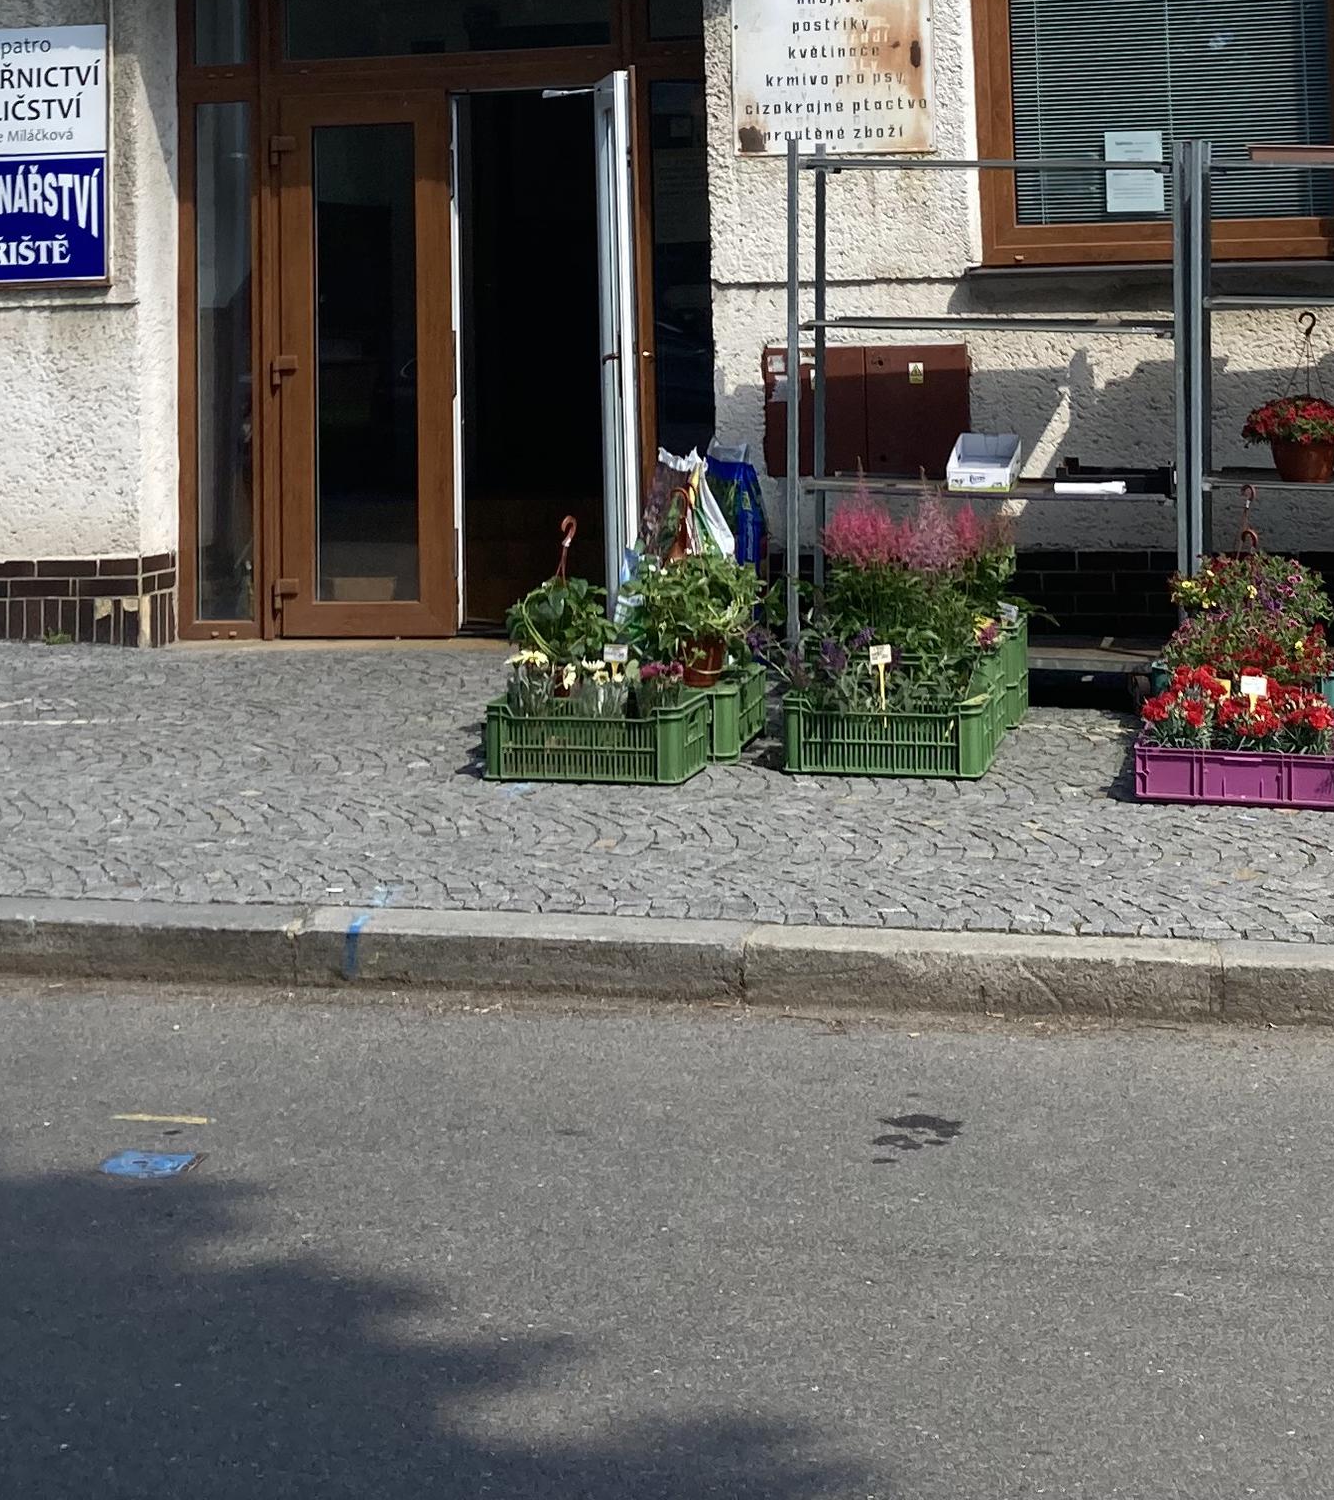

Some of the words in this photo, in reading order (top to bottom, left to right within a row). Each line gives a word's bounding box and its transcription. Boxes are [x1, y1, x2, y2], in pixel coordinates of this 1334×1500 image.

[1, 37, 52, 59] patro
[766, 73, 829, 87] krmivo
[835, 72, 865, 87] pro
[745, 99, 844, 115] cizokrajné
[7, 126, 74, 143] Miláčková
[853, 123, 904, 140] zboží
